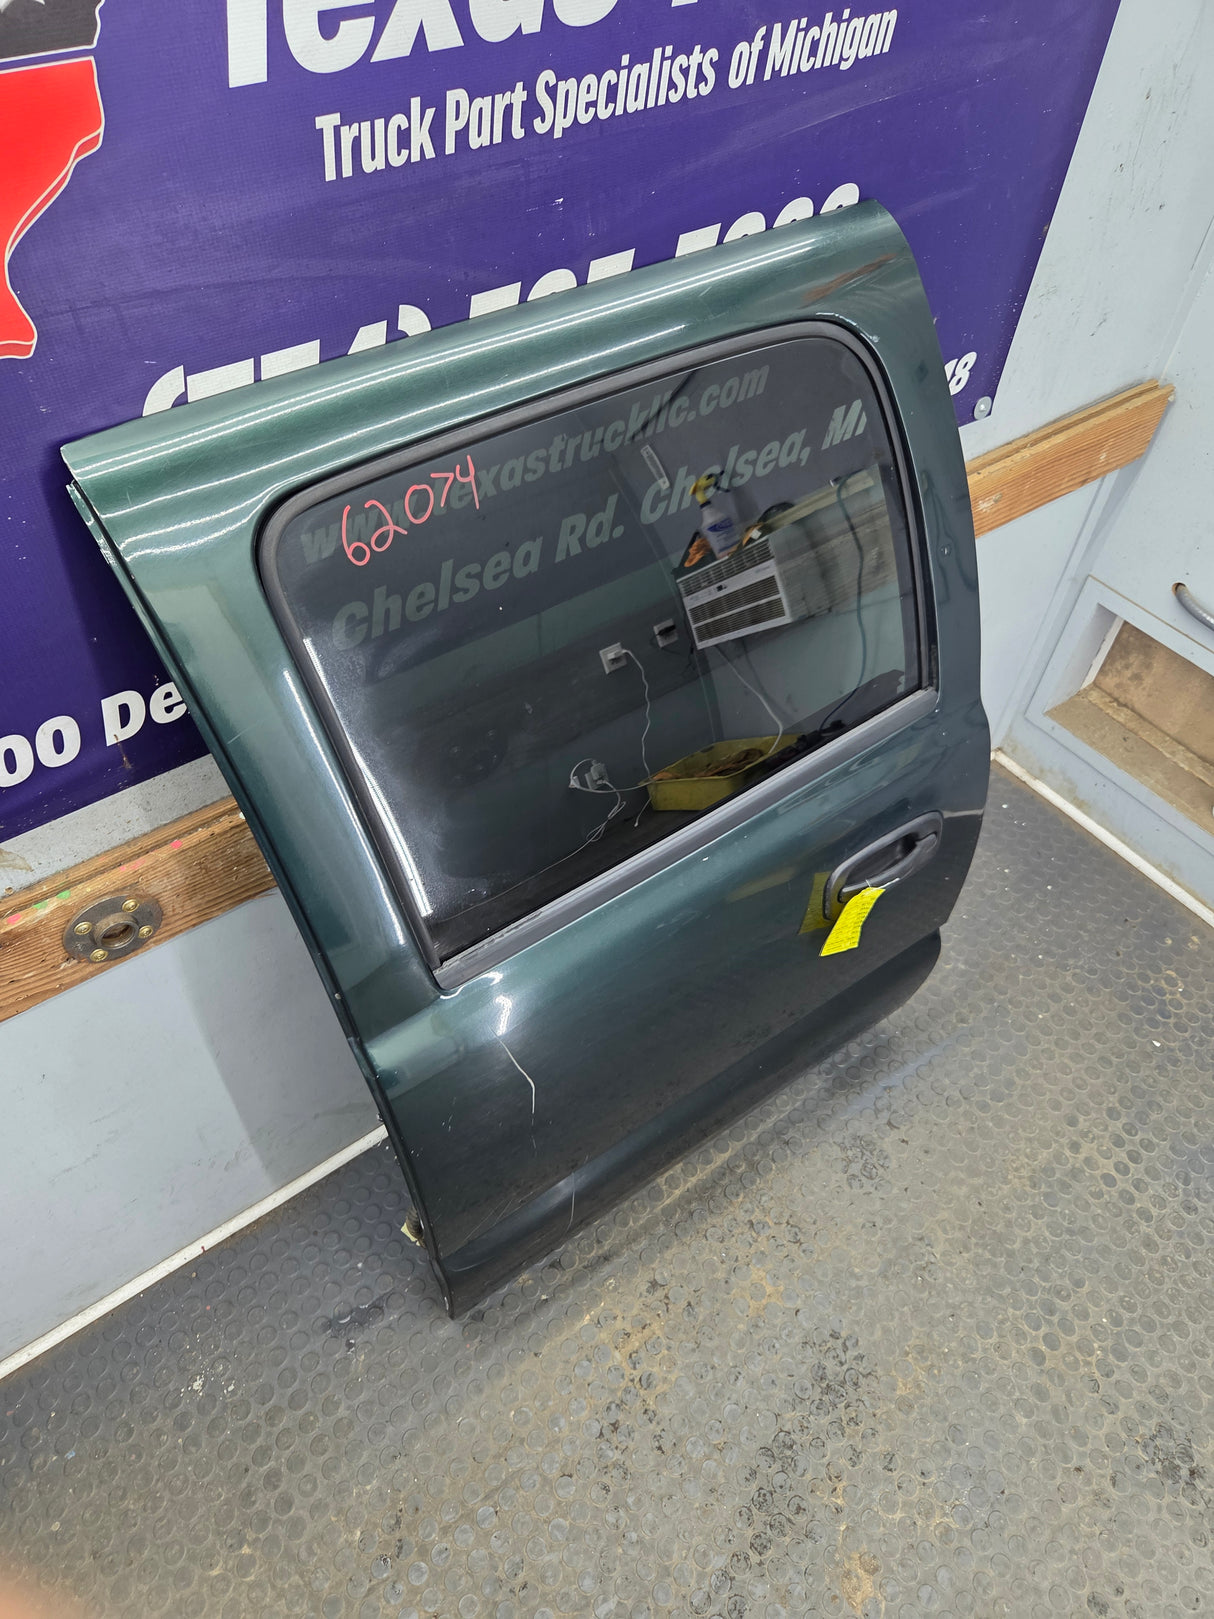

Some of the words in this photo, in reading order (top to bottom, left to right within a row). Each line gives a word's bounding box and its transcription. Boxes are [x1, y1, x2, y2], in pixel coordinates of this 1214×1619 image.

[315, 96, 436, 182] Truck
[445, 81, 528, 155] Part
[533, 44, 719, 139] Specialists
[728, 25, 767, 89] of
[763, 8, 898, 81] Michigan
[341, 454, 480, 566] 62074
[555, 493, 625, 563] Rd.
